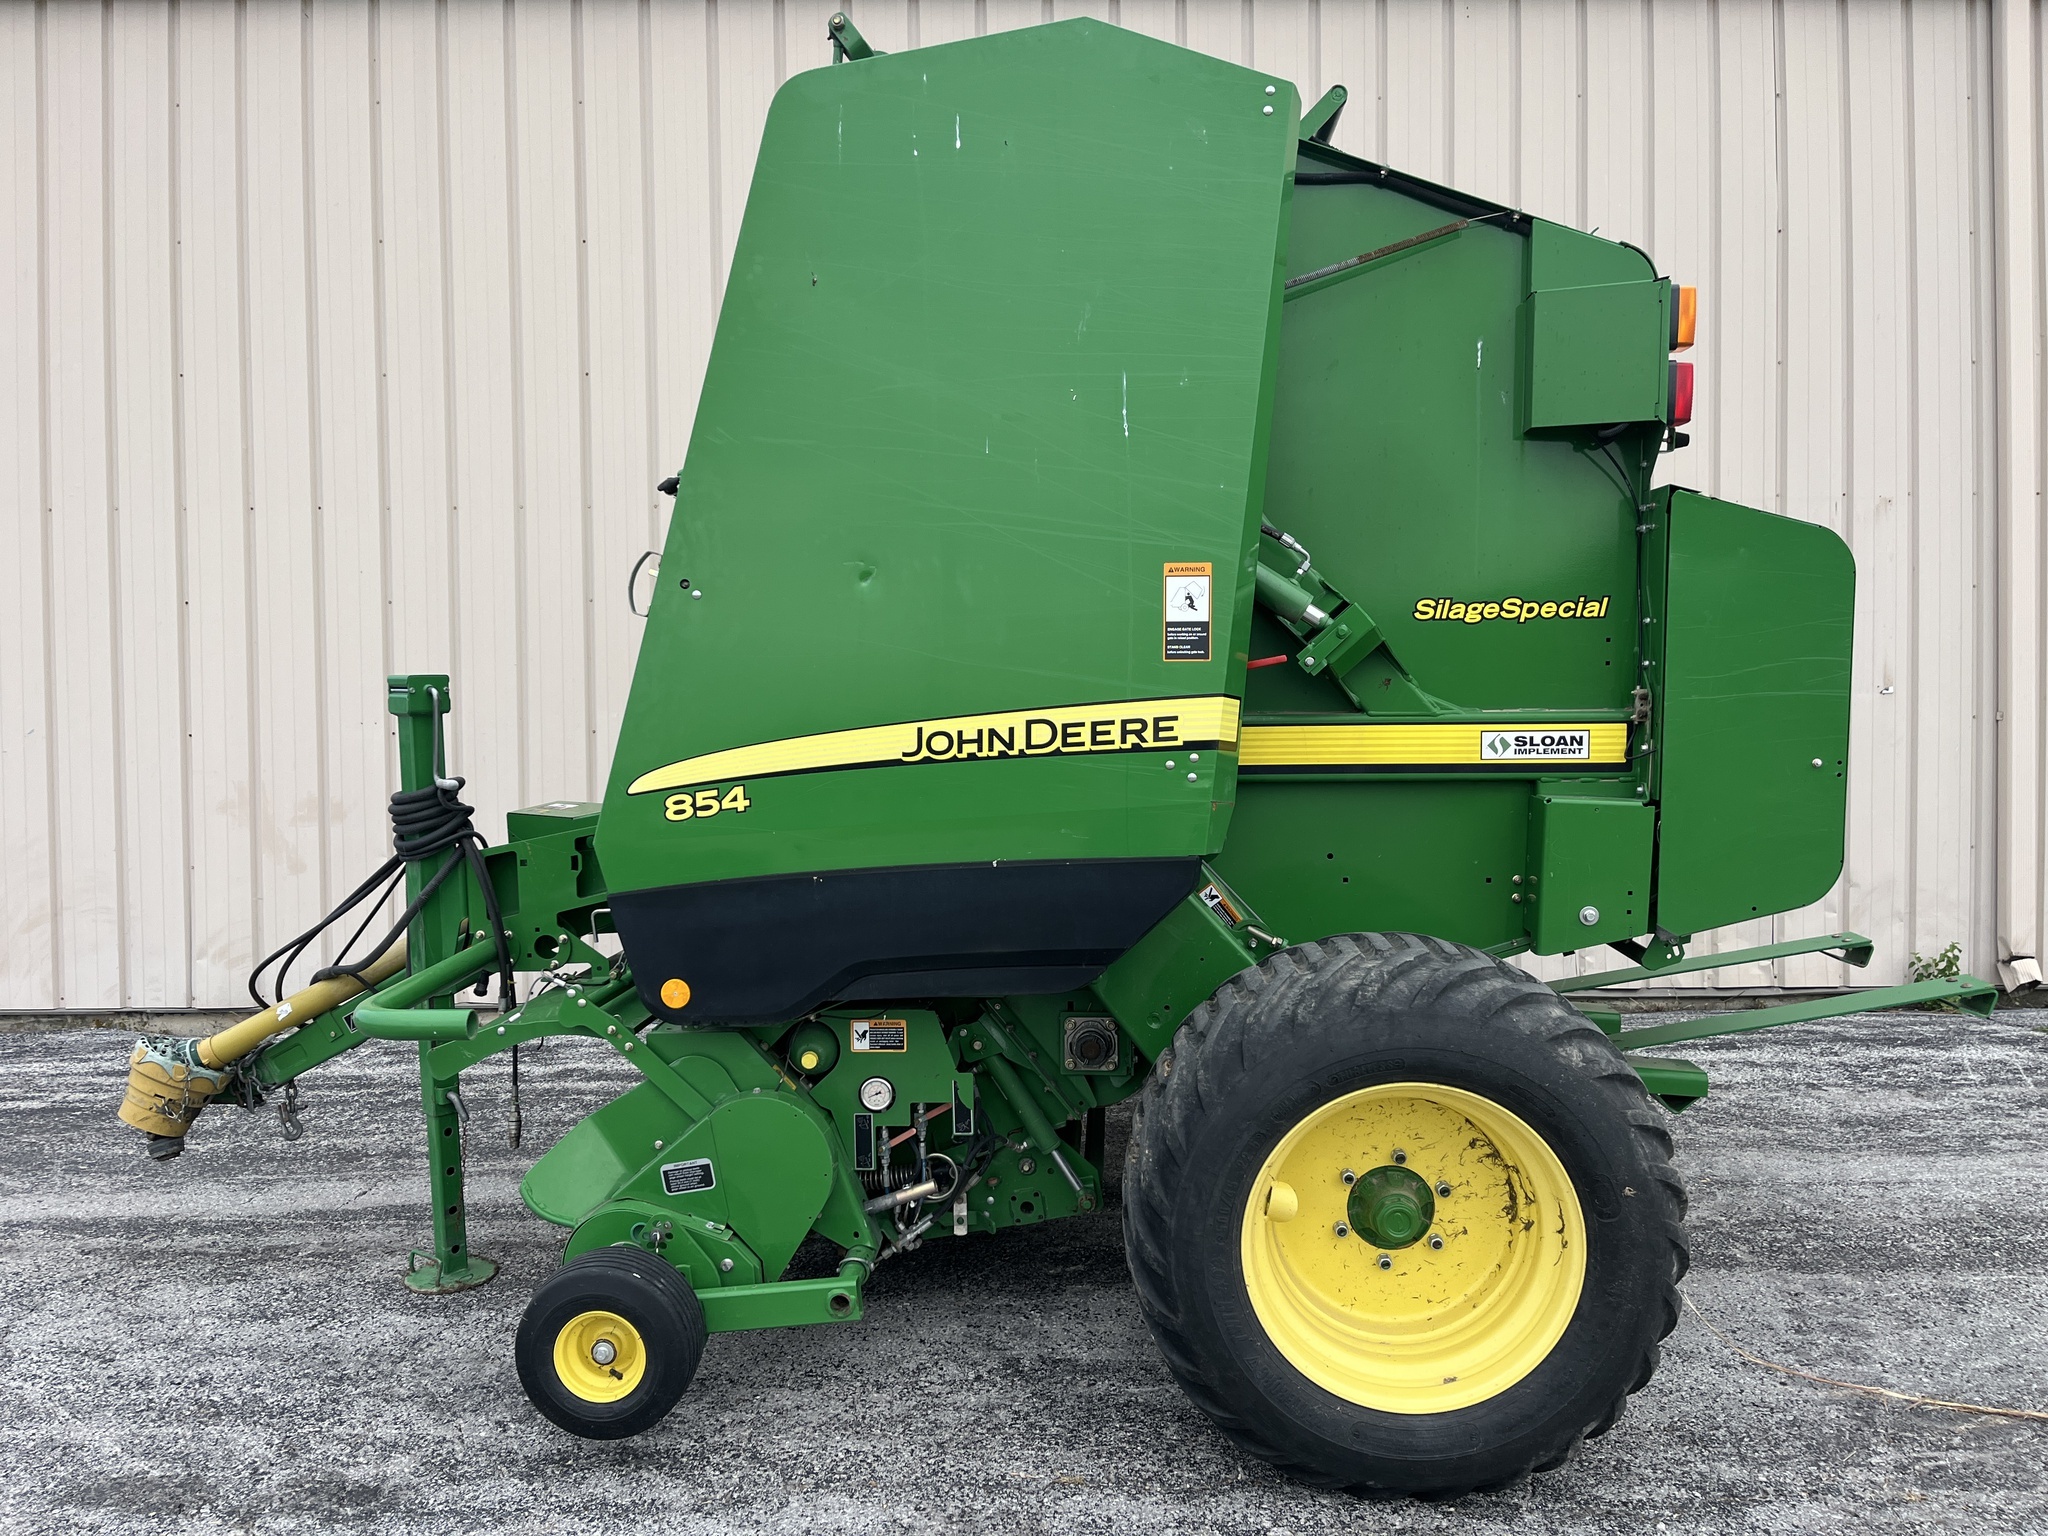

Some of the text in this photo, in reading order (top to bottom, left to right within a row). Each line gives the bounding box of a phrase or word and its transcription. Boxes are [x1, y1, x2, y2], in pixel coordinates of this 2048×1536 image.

[1413, 596, 1611, 625] SilageSpecial
[902, 716, 1179, 757] JOHN DEERE
[1514, 735, 1584, 747] SLOAN
[664, 784, 751, 822] 854
